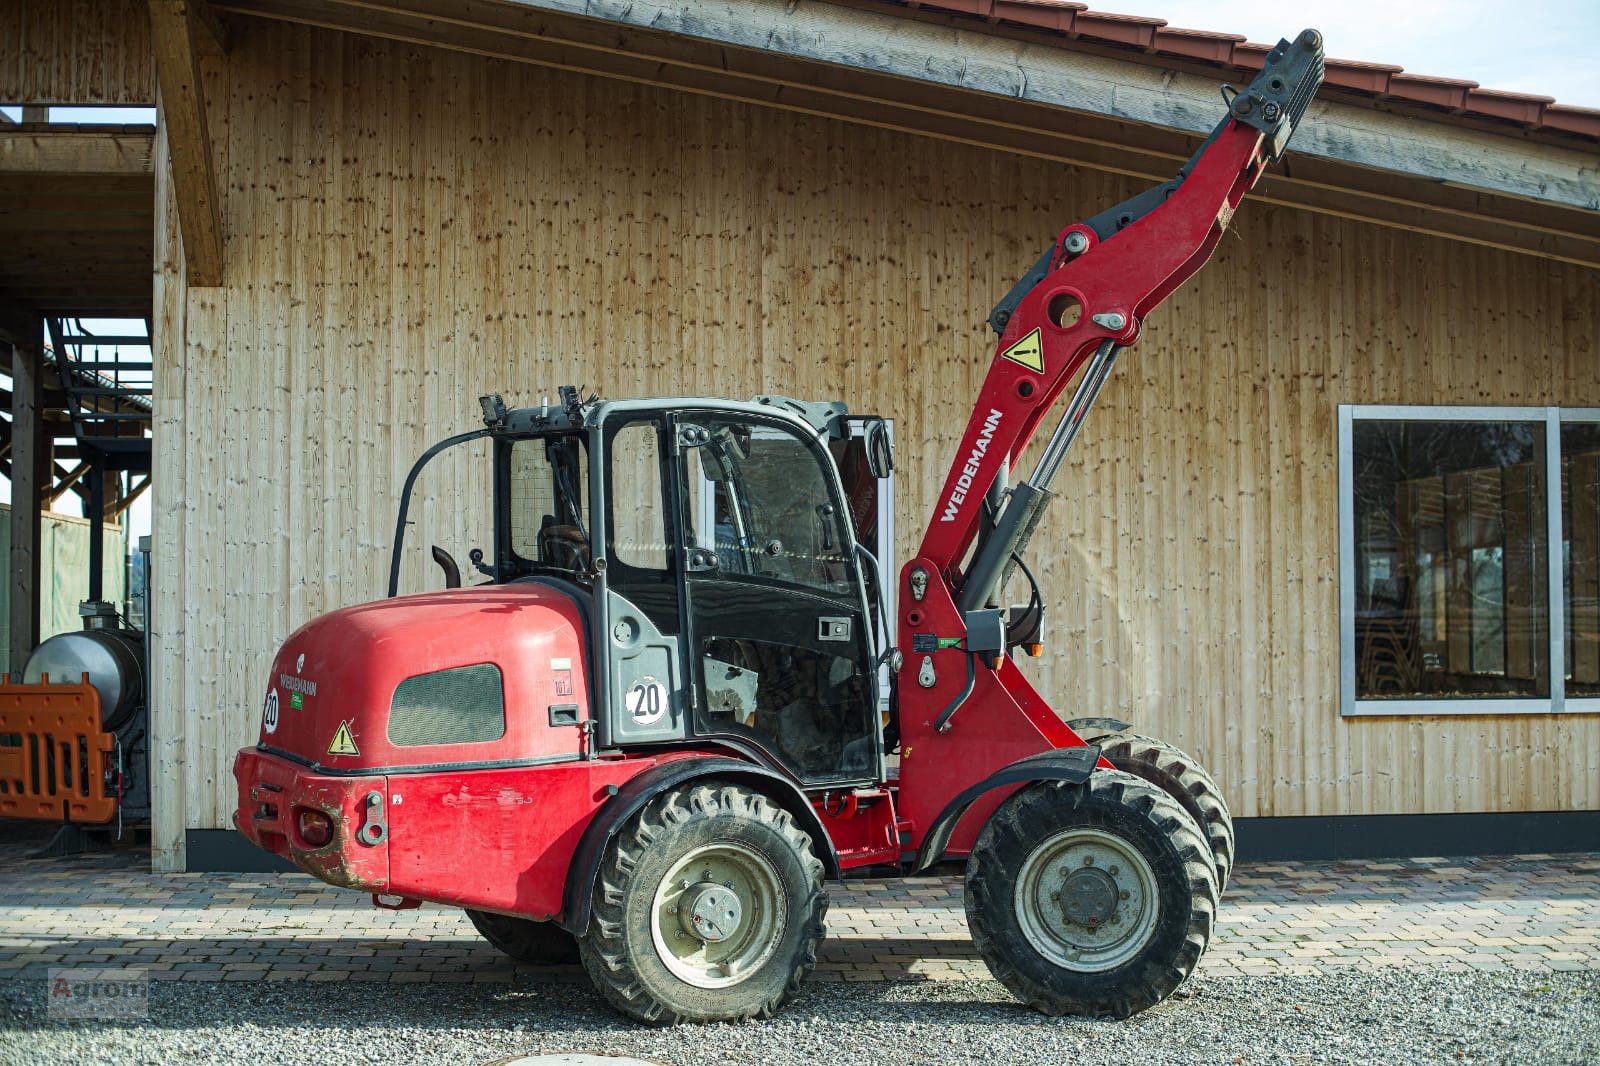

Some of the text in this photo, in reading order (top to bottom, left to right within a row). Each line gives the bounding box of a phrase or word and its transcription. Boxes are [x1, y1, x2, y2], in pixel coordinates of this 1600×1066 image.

[941, 408, 1003, 522] WEIDEMANN
[280, 673, 317, 697] WEIDEMANN
[634, 683, 660, 717] 20
[265, 695, 277, 727] 20
